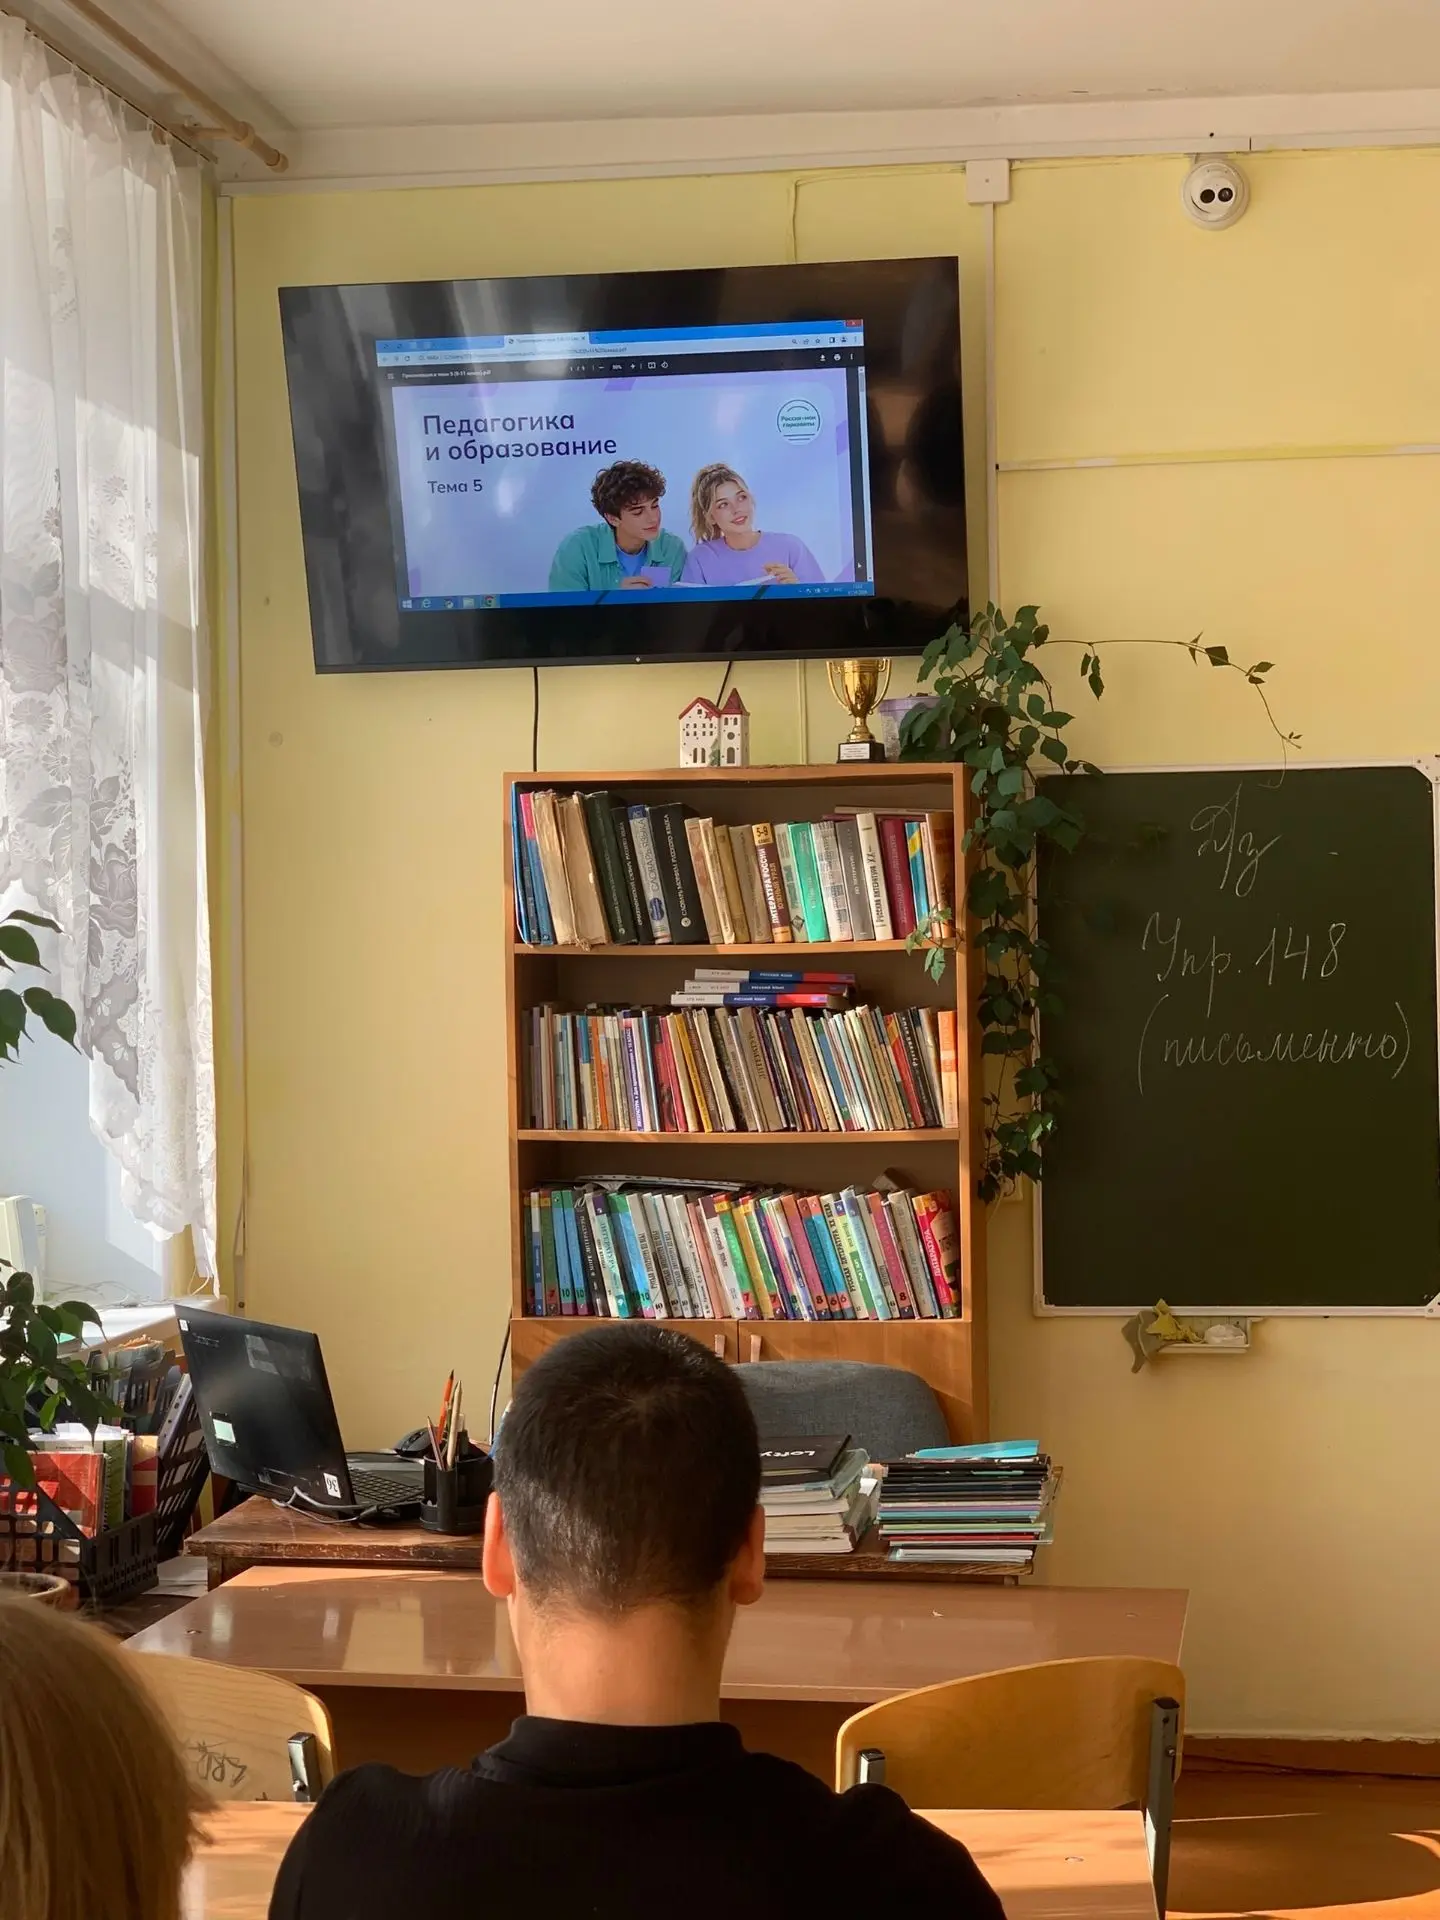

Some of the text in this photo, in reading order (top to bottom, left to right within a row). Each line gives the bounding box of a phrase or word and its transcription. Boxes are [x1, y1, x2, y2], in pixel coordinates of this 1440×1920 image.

[423, 414, 575, 437] Педагогика
[426, 439, 617, 464] и образование
[428, 479, 483, 494] Тема 5
[758, 847, 779, 924] ЛИТЕРАТУРА РОССИИ
[772, 880, 784, 909] ЮЖНЫЙ
[1142, 912, 1346, 1018] Упр. 148
[823, 1202, 832, 1217] ВЕКА
[831, 1228, 847, 1264] ЛИТЕРАТУРА
[923, 1227, 942, 1277] ЛИТЕРАТУРА
[842, 1266, 855, 1292] РУССКАЯ
[562, 1289, 570, 1298] 10
[576, 1289, 584, 1298] 10
[743, 1293, 749, 1301] 7
[770, 1294, 777, 1303] 7
[816, 1295, 823, 1304] 8
[830, 1297, 837, 1305] 6
[900, 1292, 907, 1301] 8
